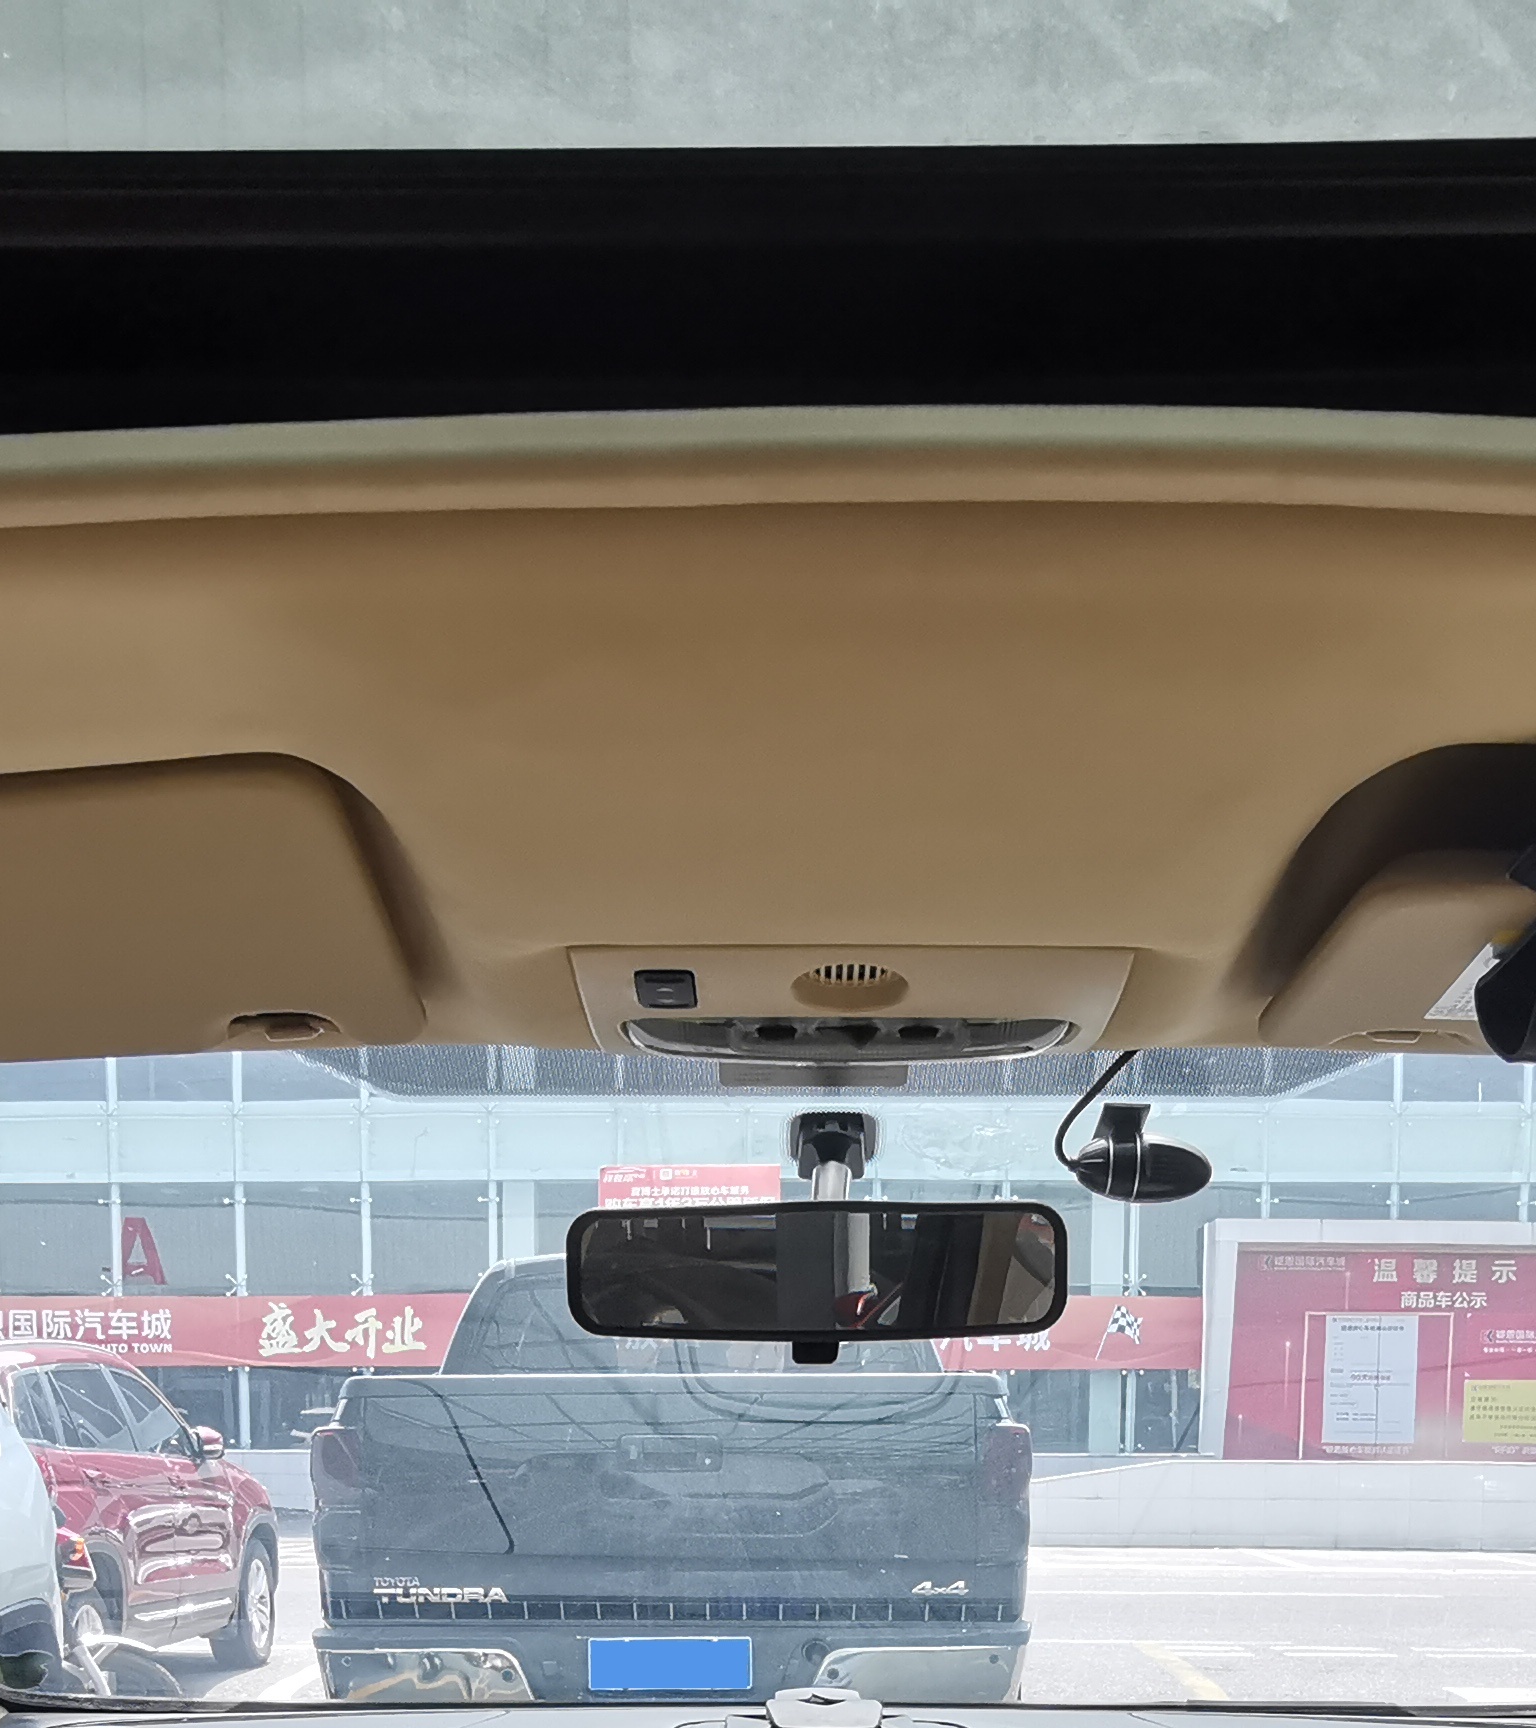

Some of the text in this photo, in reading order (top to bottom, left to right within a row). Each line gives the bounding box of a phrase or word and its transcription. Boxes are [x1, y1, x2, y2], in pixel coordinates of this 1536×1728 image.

[1372, 1257, 1518, 1284] 温馨提示
[1400, 1291, 1488, 1309] 商品车公示
[258, 1301, 427, 1358] 盛大开业
[94, 1342, 173, 1354] UTO TOWN
[373, 1576, 422, 1587] TOYOTA
[372, 1587, 510, 1604] TUNDRA
